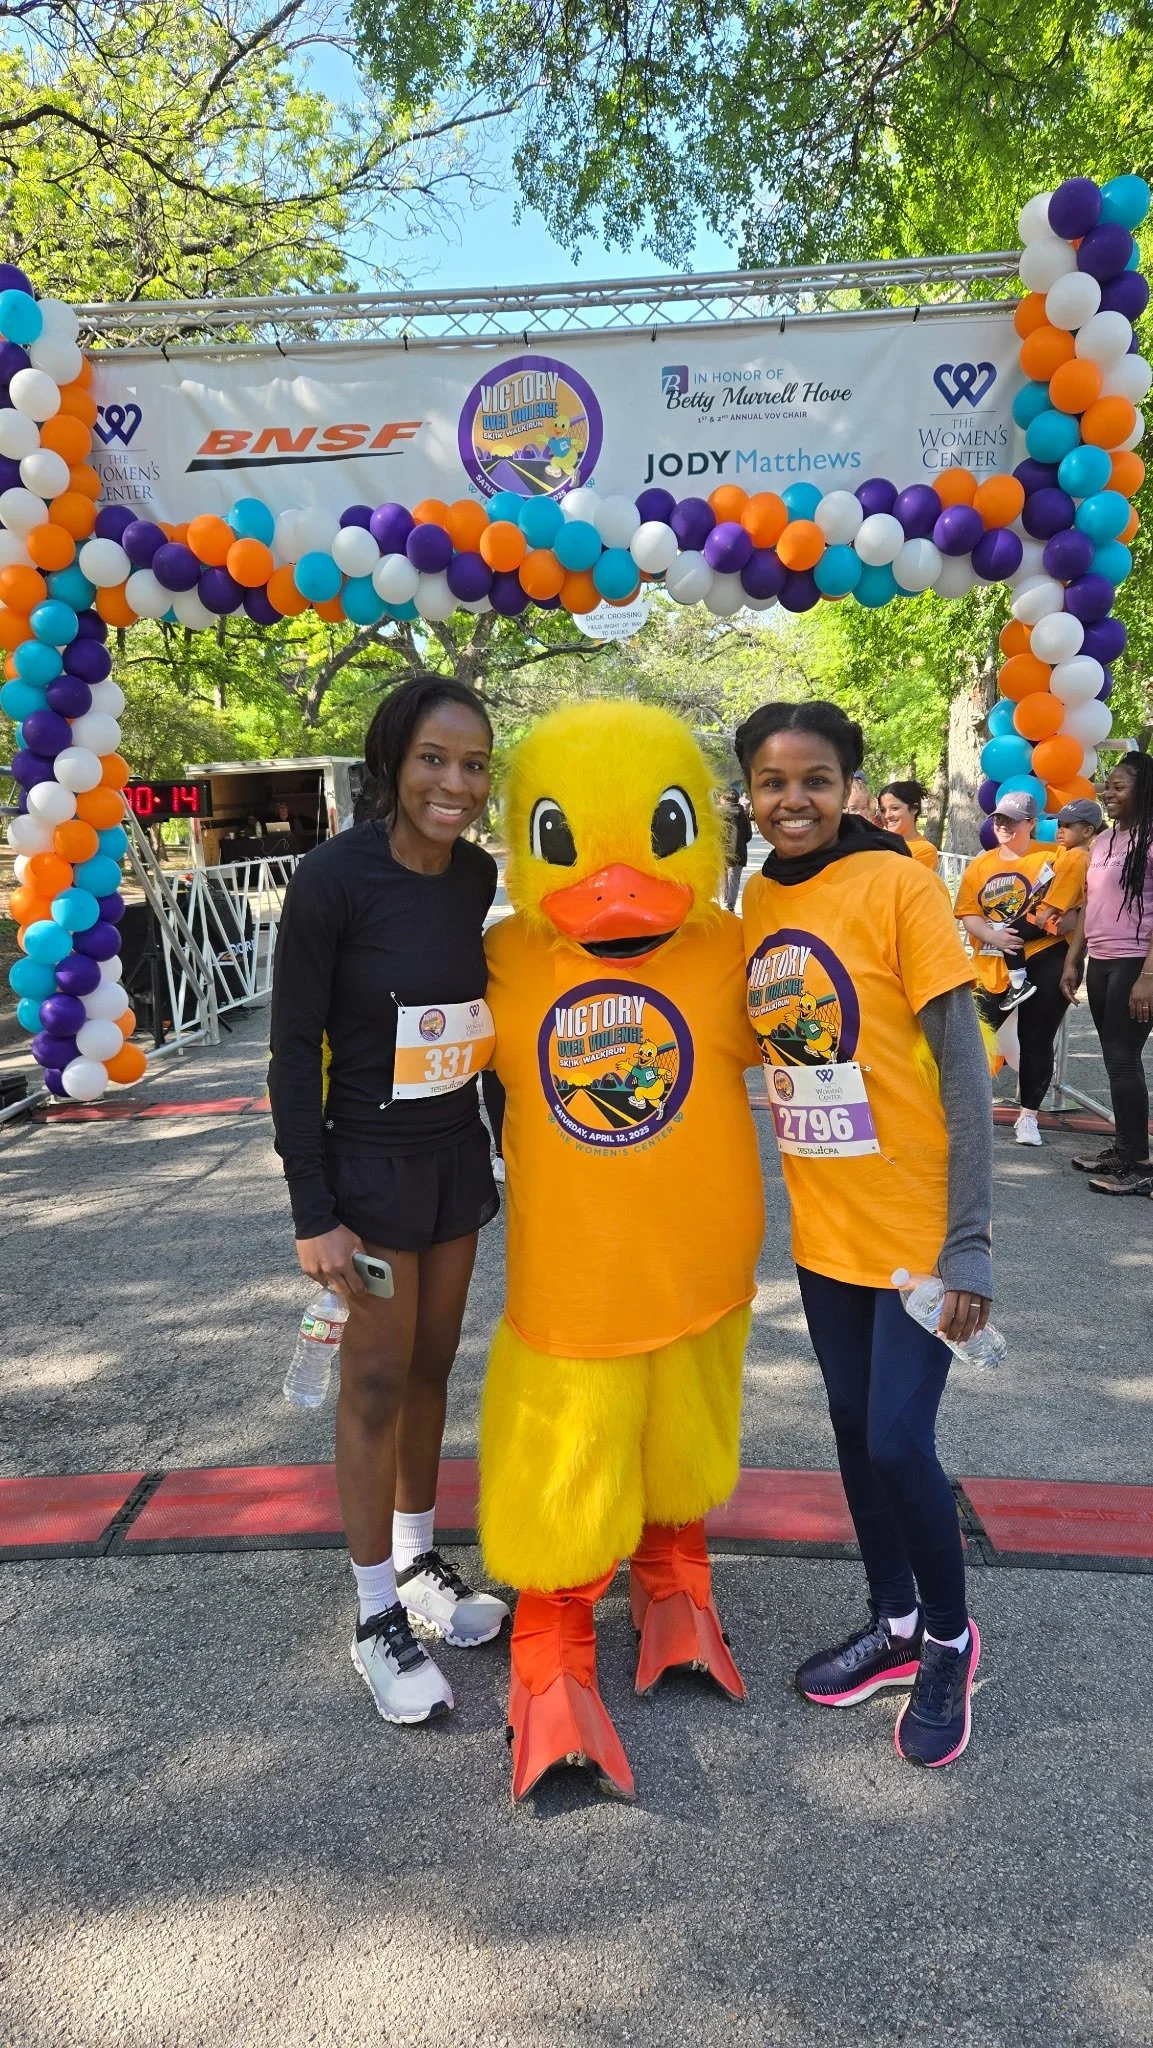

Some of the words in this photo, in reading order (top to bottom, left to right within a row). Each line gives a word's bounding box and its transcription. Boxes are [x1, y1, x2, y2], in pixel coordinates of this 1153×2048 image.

[694, 373, 707, 384] IN
[712, 369, 761, 382] HONOR
[766, 368, 784, 380] OF
[480, 371, 559, 414] VICTORY
[666, 389, 716, 412] Betty
[722, 382, 799, 407] Murrell
[802, 381, 852, 403] Hove
[482, 413, 509, 430] OVER
[511, 401, 558, 426] VIOLENCE
[730, 413, 763, 421] ANNUAL
[765, 412, 781, 420] VOV
[783, 411, 808, 419] CHAIR
[951, 417, 975, 429] THE
[195, 420, 424, 456] BNSF
[918, 424, 1008, 448] WOMEN'S
[106, 454, 129, 464] THE
[644, 450, 732, 484] JODY
[735, 448, 862, 474] Matthews
[922, 448, 998, 469] CENTER
[551, 488, 568, 502] 025
[607, 611, 643, 620] CROSSING
[749, 945, 812, 988] VICTORY
[555, 995, 646, 1038] VICTORY
[558, 1037, 586, 1057] OVER
[588, 1026, 643, 1053] VIOLENCE
[583, 1046, 626, 1065] WALK|RUN
[423, 1043, 474, 1081] 331
[554, 1104, 588, 1138] SATURDAY,
[588, 1131, 615, 1143] APRIL
[616, 1134, 629, 1143] 12,
[628, 1125, 650, 1140] 2025
[778, 1107, 854, 1141] 2796
[555, 1127, 571, 1144] THE
[575, 1142, 629, 1157] WOMEN'S
[633, 1125, 675, 1153] CENTER
